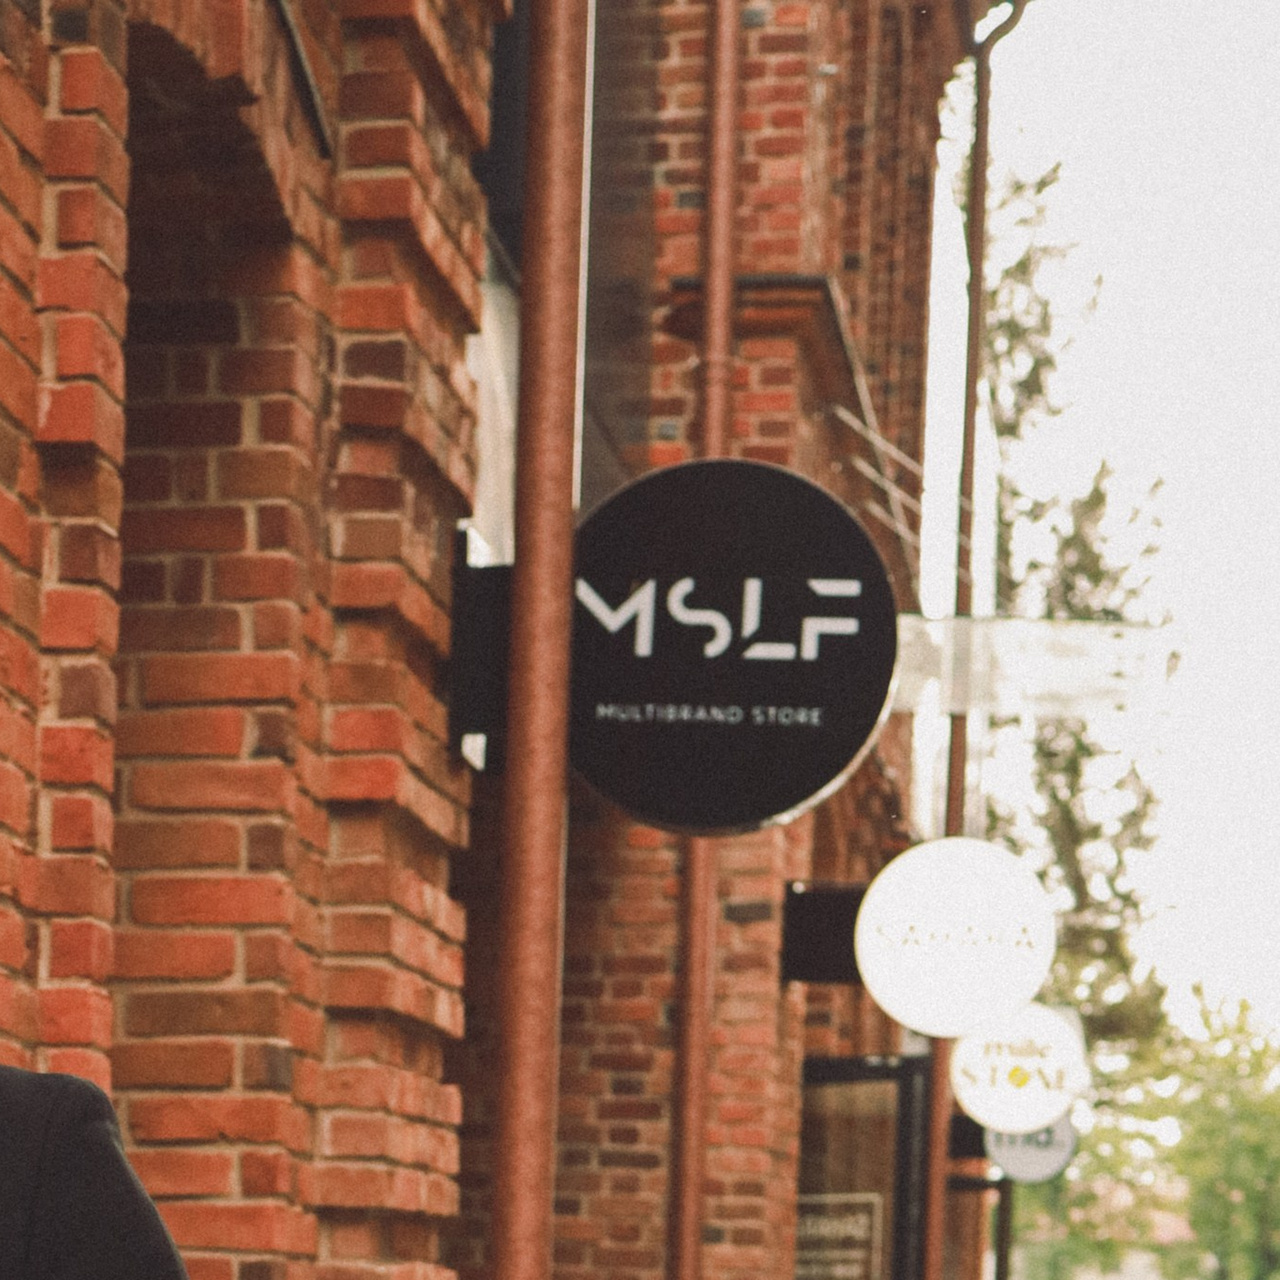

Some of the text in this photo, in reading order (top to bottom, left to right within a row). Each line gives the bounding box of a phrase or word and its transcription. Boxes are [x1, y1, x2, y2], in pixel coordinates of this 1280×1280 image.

[575, 576, 862, 661] MSLF
[595, 702, 824, 728] MULTIBRAND STORE
